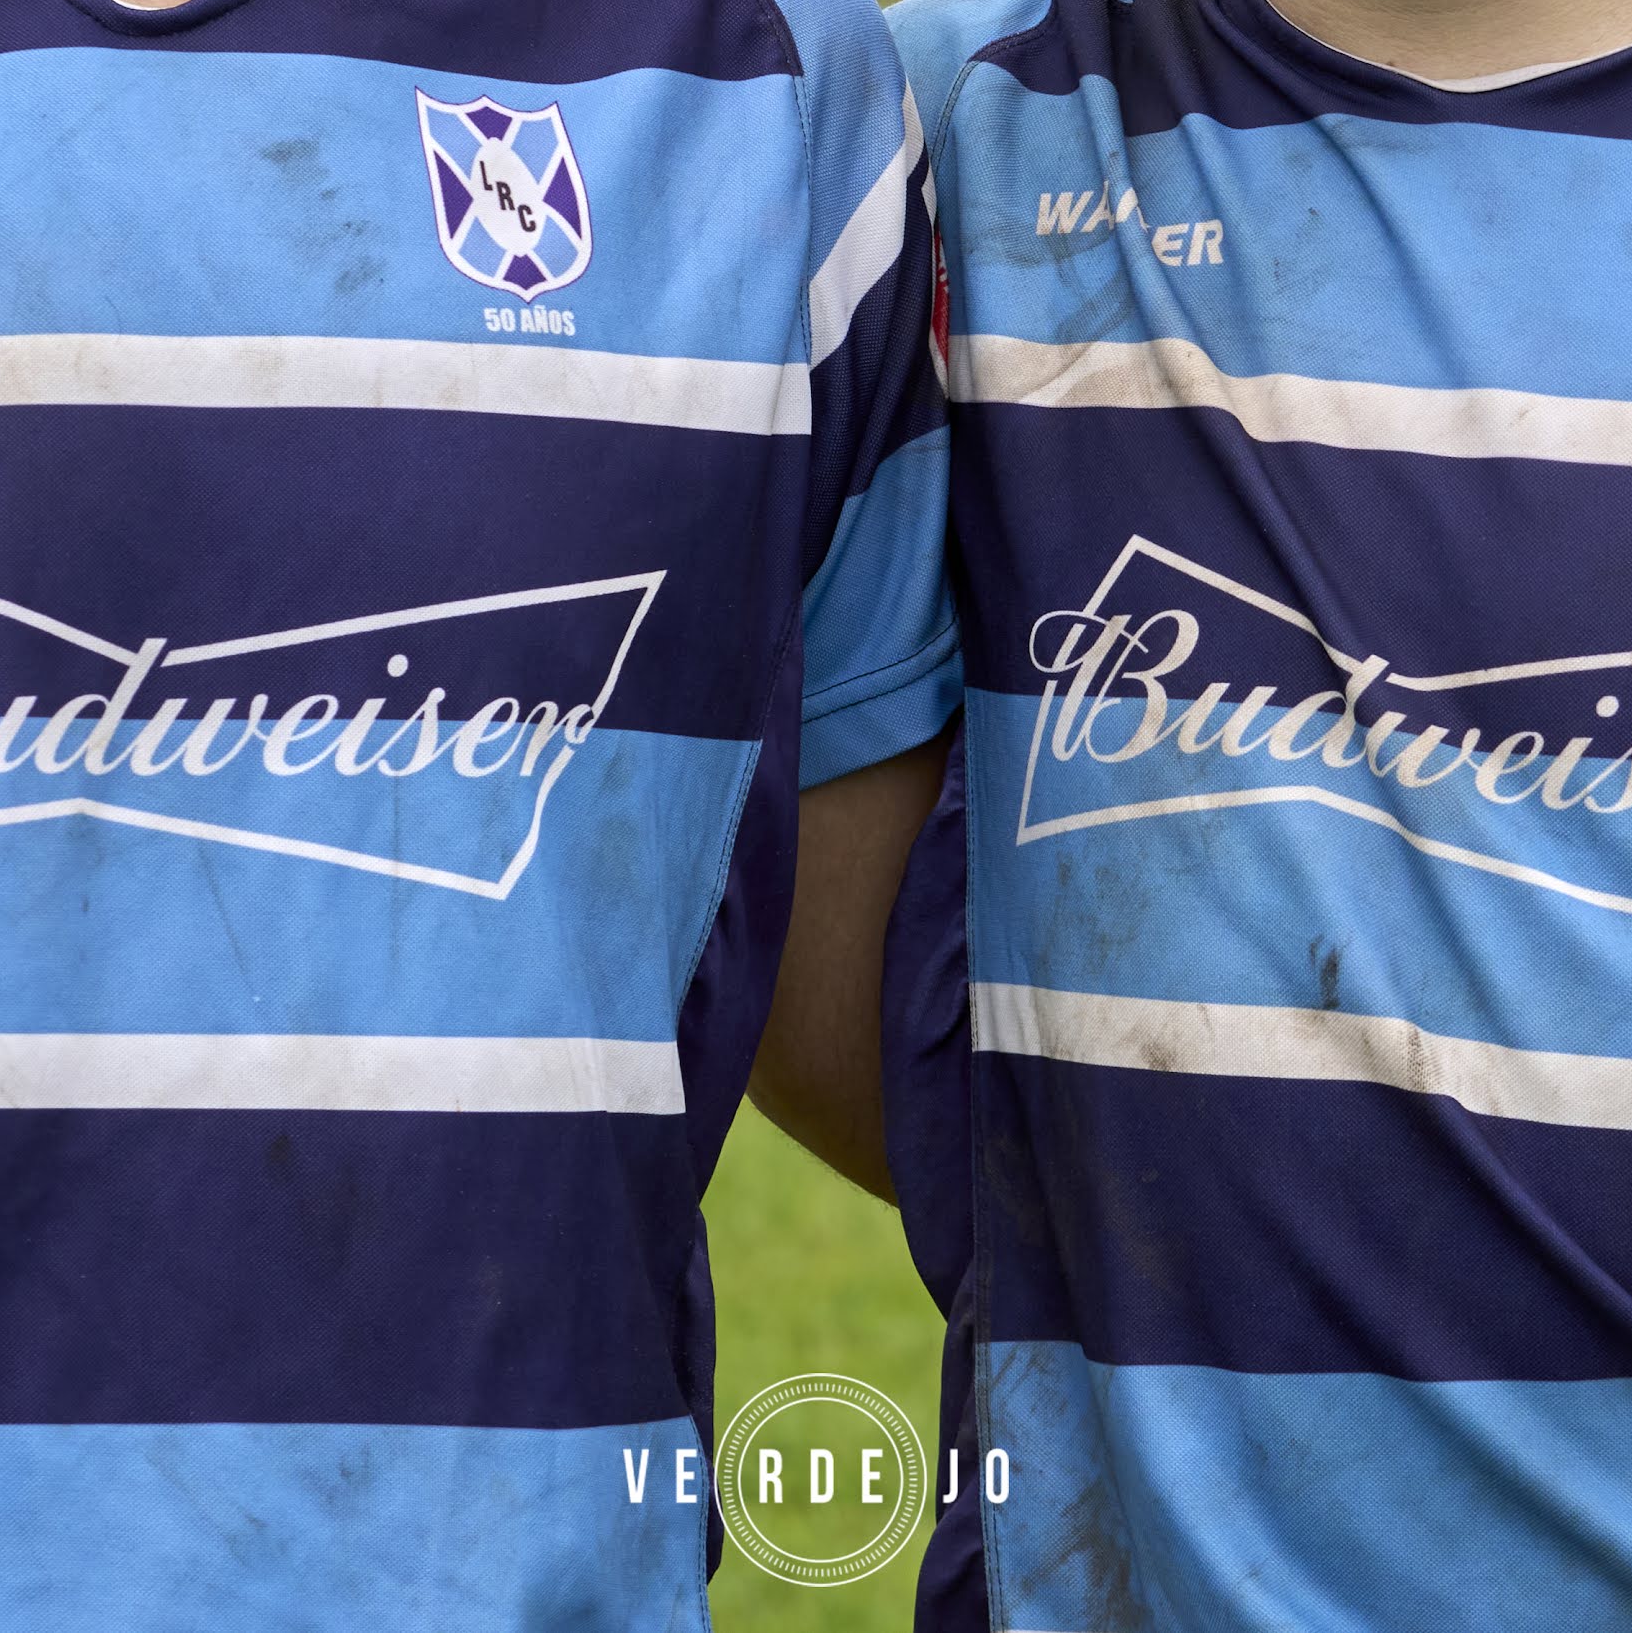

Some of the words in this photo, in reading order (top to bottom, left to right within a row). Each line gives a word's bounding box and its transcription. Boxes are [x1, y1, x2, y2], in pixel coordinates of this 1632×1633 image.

[1035, 180, 1224, 267] WAER
[483, 307, 516, 333] 50
[520, 304, 576, 337] AÑOS
